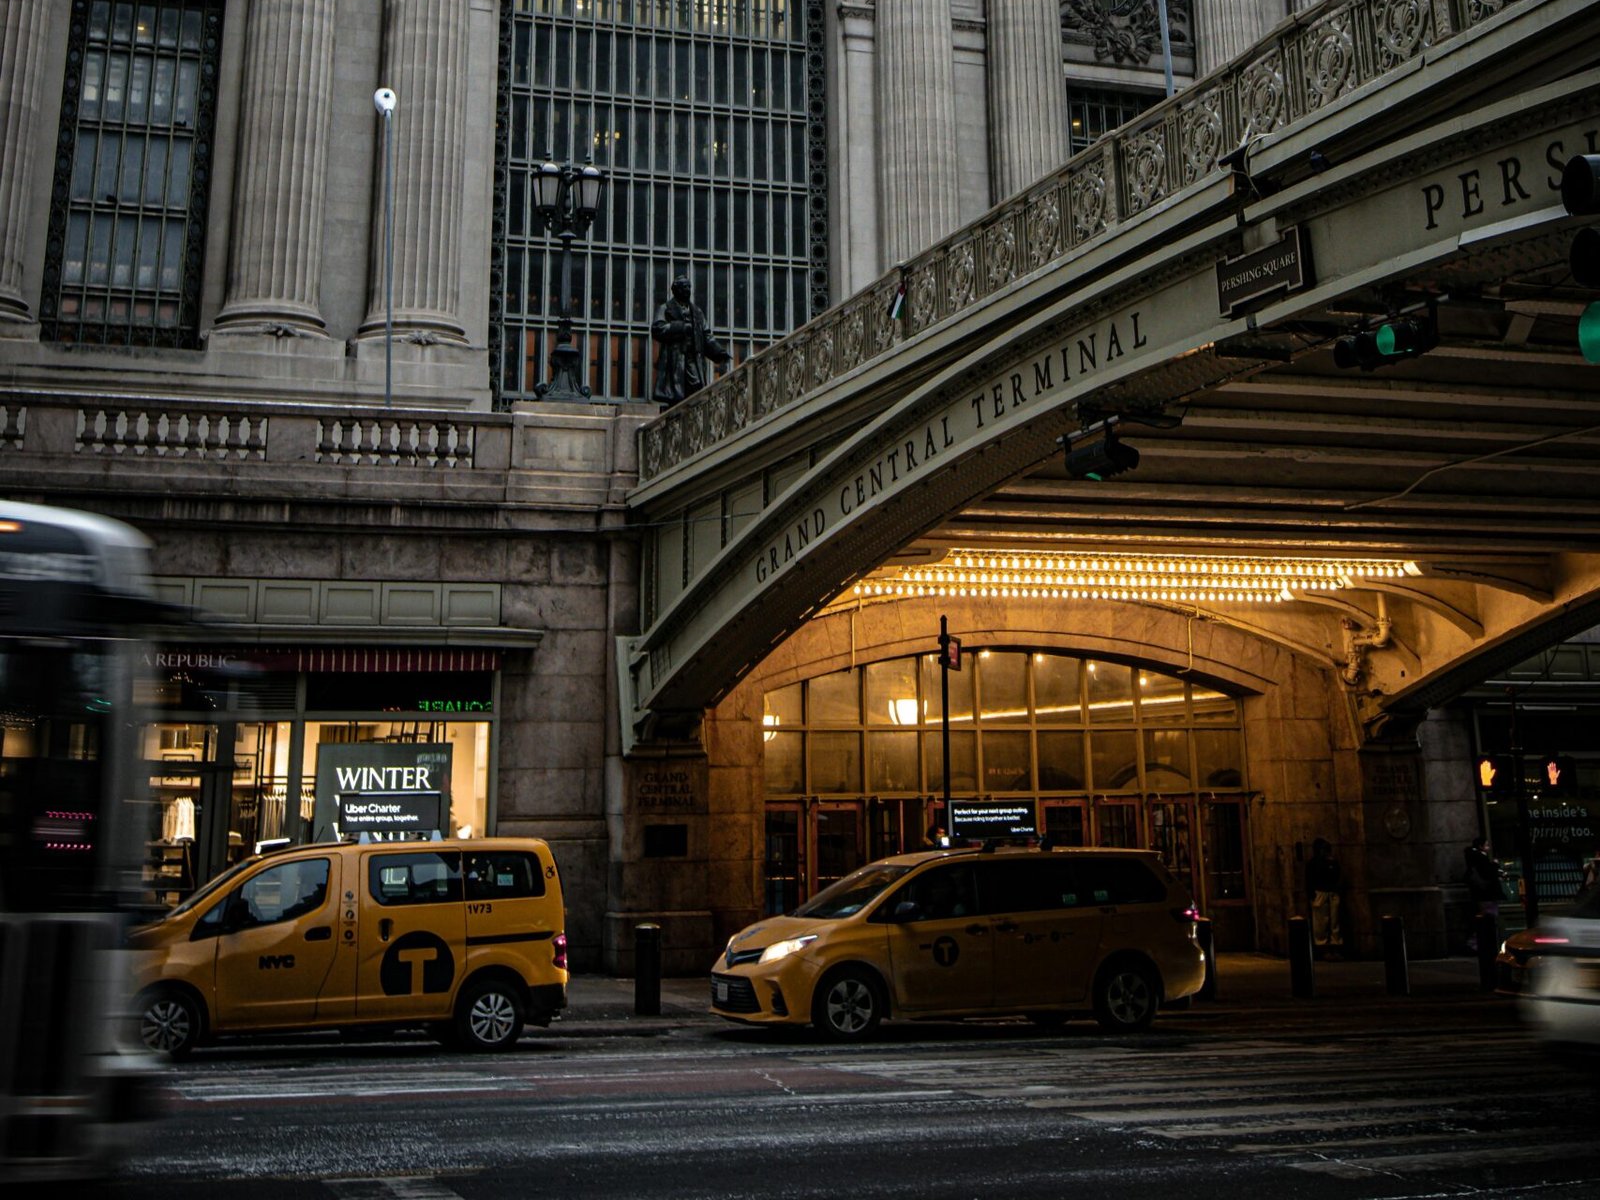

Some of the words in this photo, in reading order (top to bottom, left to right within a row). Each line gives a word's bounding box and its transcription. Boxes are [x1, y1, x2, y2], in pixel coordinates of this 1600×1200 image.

[1421, 130, 1600, 230] PERS
[1221, 266, 1262, 293] PERSHING
[1262, 251, 1297, 276] SQUARE
[756, 508, 826, 584] GRAND
[840, 416, 955, 515] CENTRAL
[971, 311, 1148, 429] TERMINAL
[335, 766, 432, 790] WINTER
[345, 803, 367, 814] Uber
[368, 803, 401, 814] Charter
[1542, 805, 1588, 818] inside's
[1529, 822, 1570, 844] piring
[1571, 826, 1595, 837] too.
[467, 903, 492, 914] 1V73
[258, 954, 295, 970] NYC
